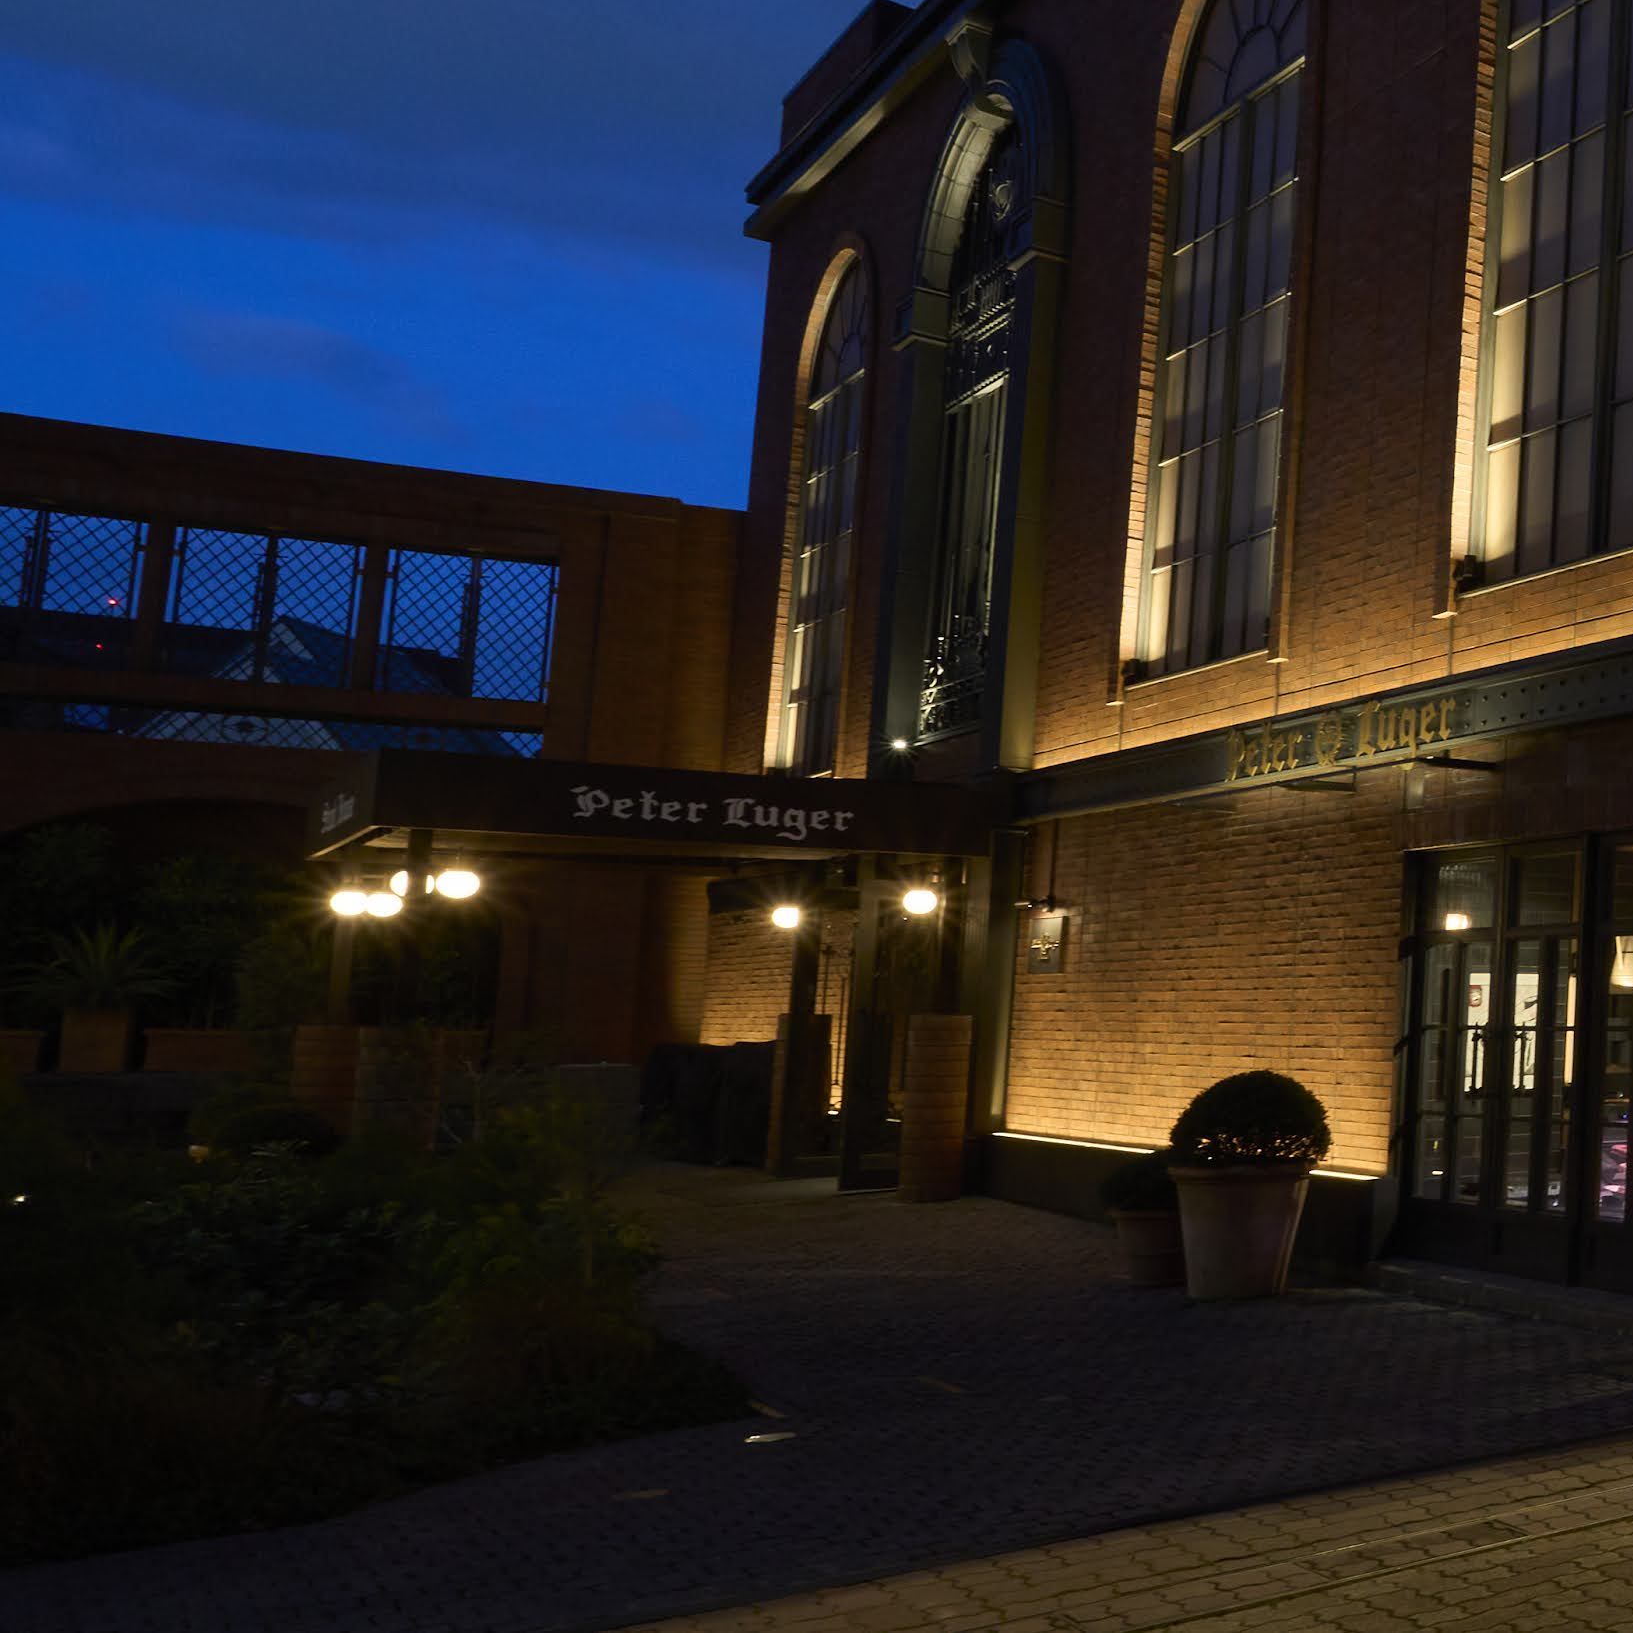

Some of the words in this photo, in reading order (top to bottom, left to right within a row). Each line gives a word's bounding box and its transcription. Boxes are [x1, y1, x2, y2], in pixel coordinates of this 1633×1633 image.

[1225, 722, 1302, 782] Peter
[1356, 697, 1456, 770] Luger
[568, 783, 708, 824] Peter
[722, 797, 855, 841] Luger
